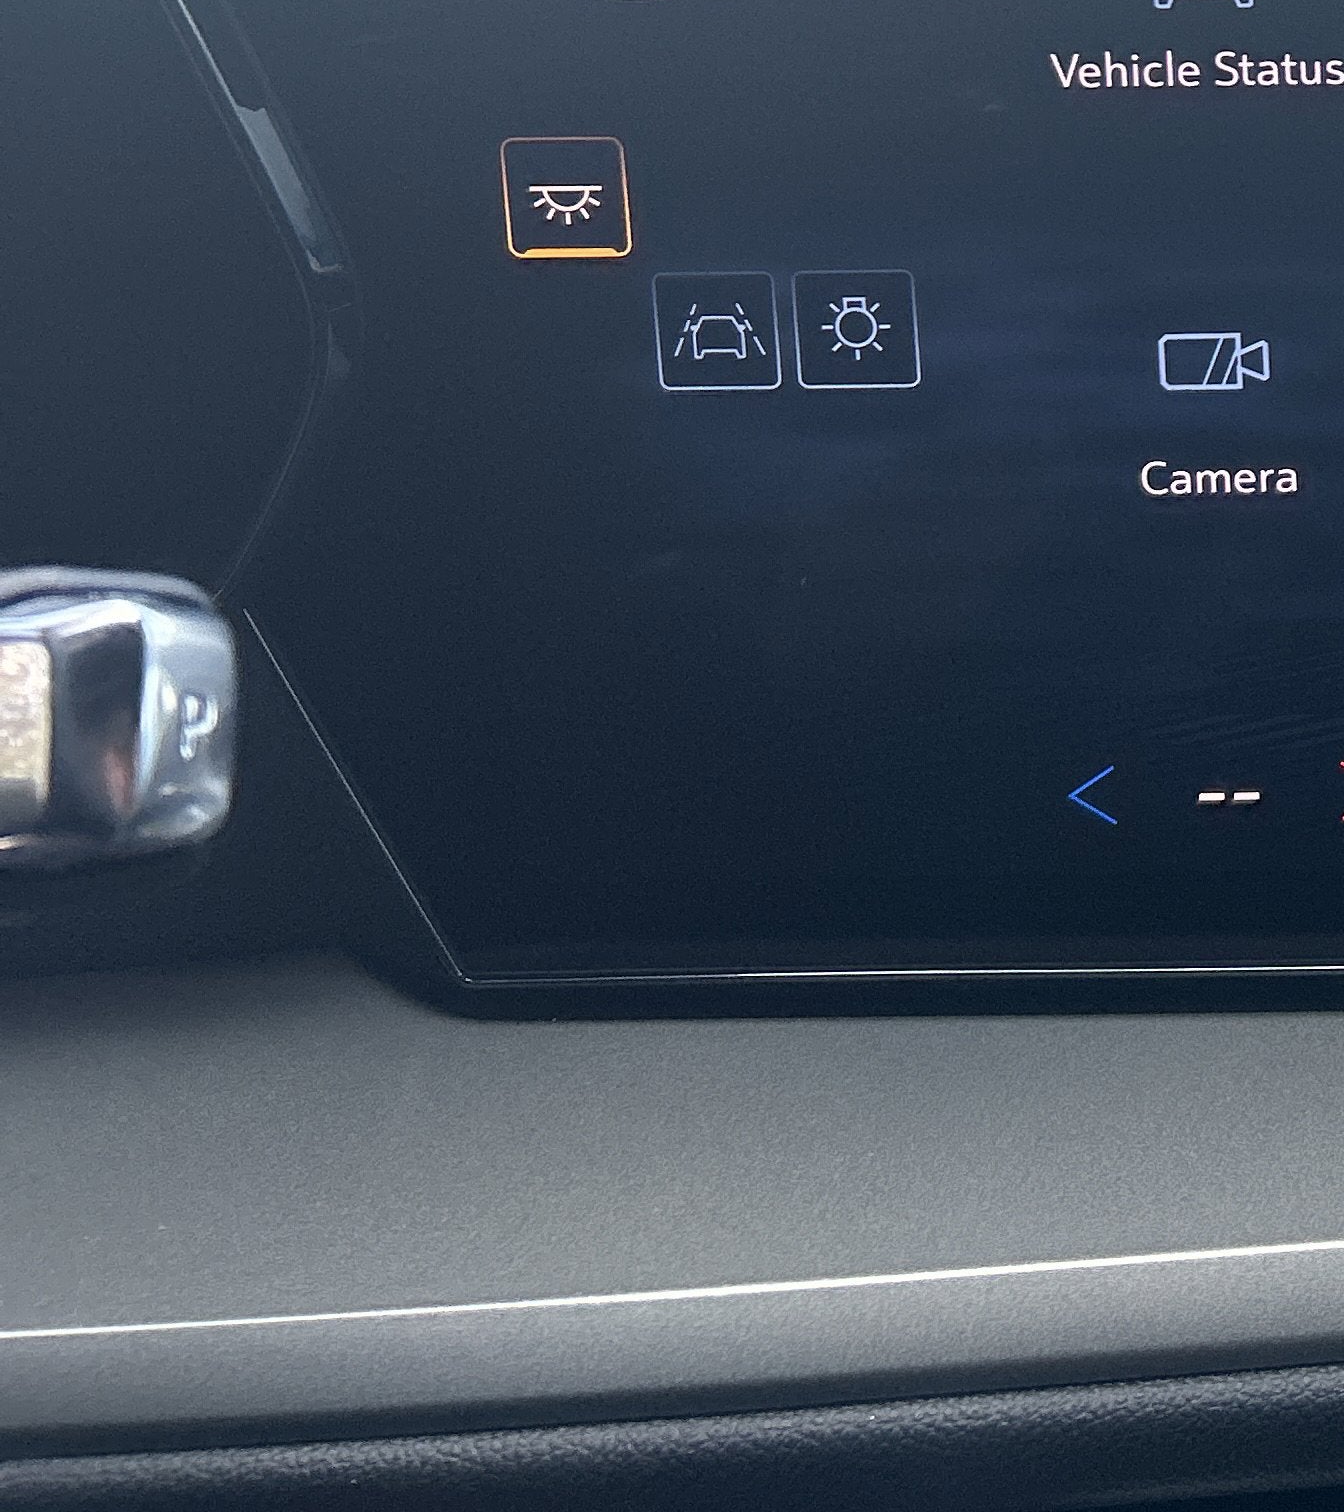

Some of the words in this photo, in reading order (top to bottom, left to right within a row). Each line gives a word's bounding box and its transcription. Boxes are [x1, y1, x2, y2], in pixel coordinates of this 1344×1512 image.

[1049, 50, 1201, 89] Vehicle
[1140, 460, 1298, 496] Camera
[178, 690, 221, 762] P
